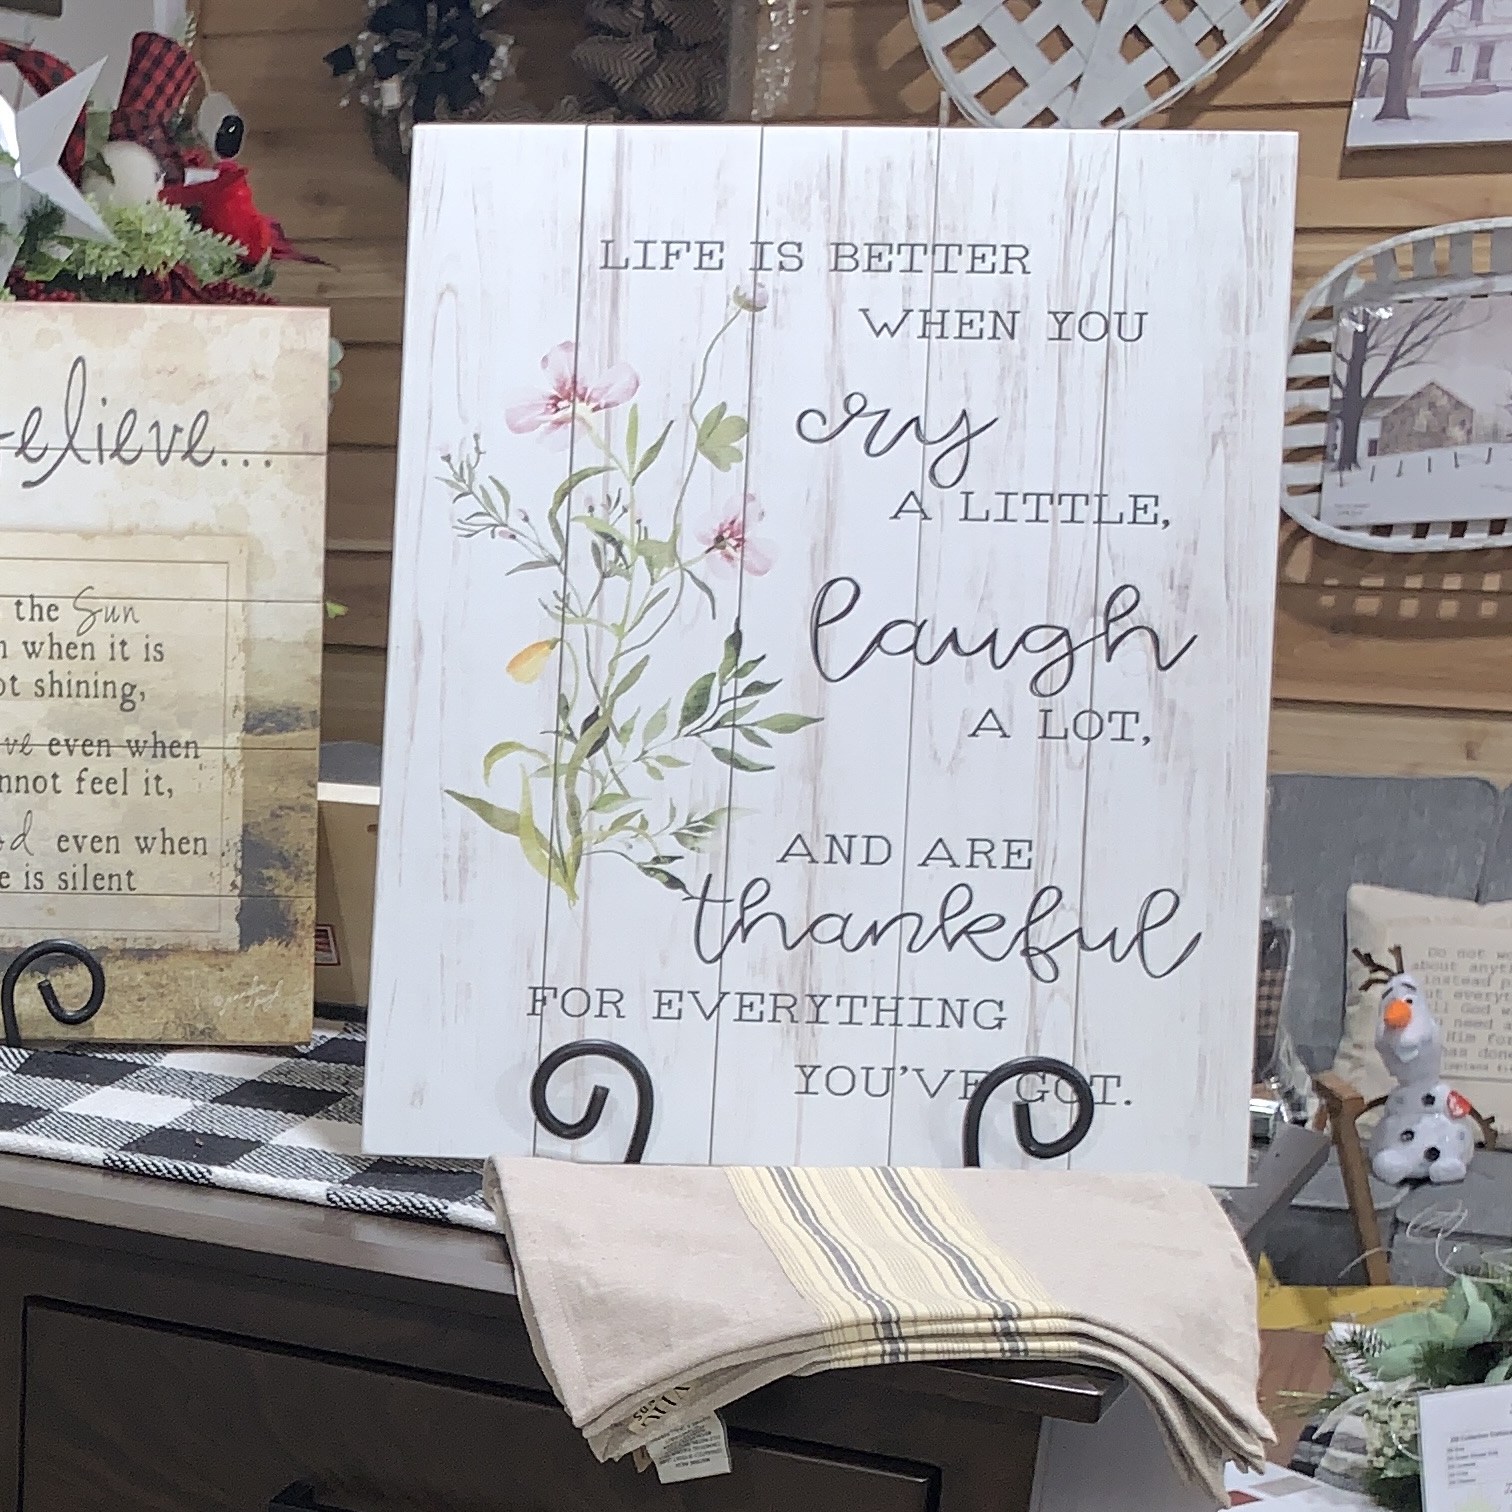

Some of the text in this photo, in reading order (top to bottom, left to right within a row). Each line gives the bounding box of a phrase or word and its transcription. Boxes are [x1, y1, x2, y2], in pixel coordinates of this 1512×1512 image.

[599, 239, 1031, 275] LIFE IS BETTER
[859, 308, 1148, 343] WHEN YOU
[795, 391, 999, 490] cry
[889, 490, 1171, 531] A LITTLE,
[15, 597, 60, 622] the
[72, 586, 141, 636] Sun
[22, 632, 96, 661] when
[109, 635, 130, 662] it
[143, 635, 165, 663] is
[809, 576, 1199, 698] laugh
[33, 671, 146, 713] shining,
[48, 737, 112, 758] even
[125, 731, 200, 760] when
[968, 707, 1151, 748] A LOT,
[75, 768, 129, 796] feel
[143, 770, 174, 800] it,
[57, 834, 120, 854] even
[134, 827, 208, 856] when
[776, 833, 1034, 871] AND ARE
[23, 863, 44, 891] is
[57, 863, 138, 893] silent
[682, 873, 1202, 984] thankful
[526, 985, 1008, 1031] FOR EVERYTHING
